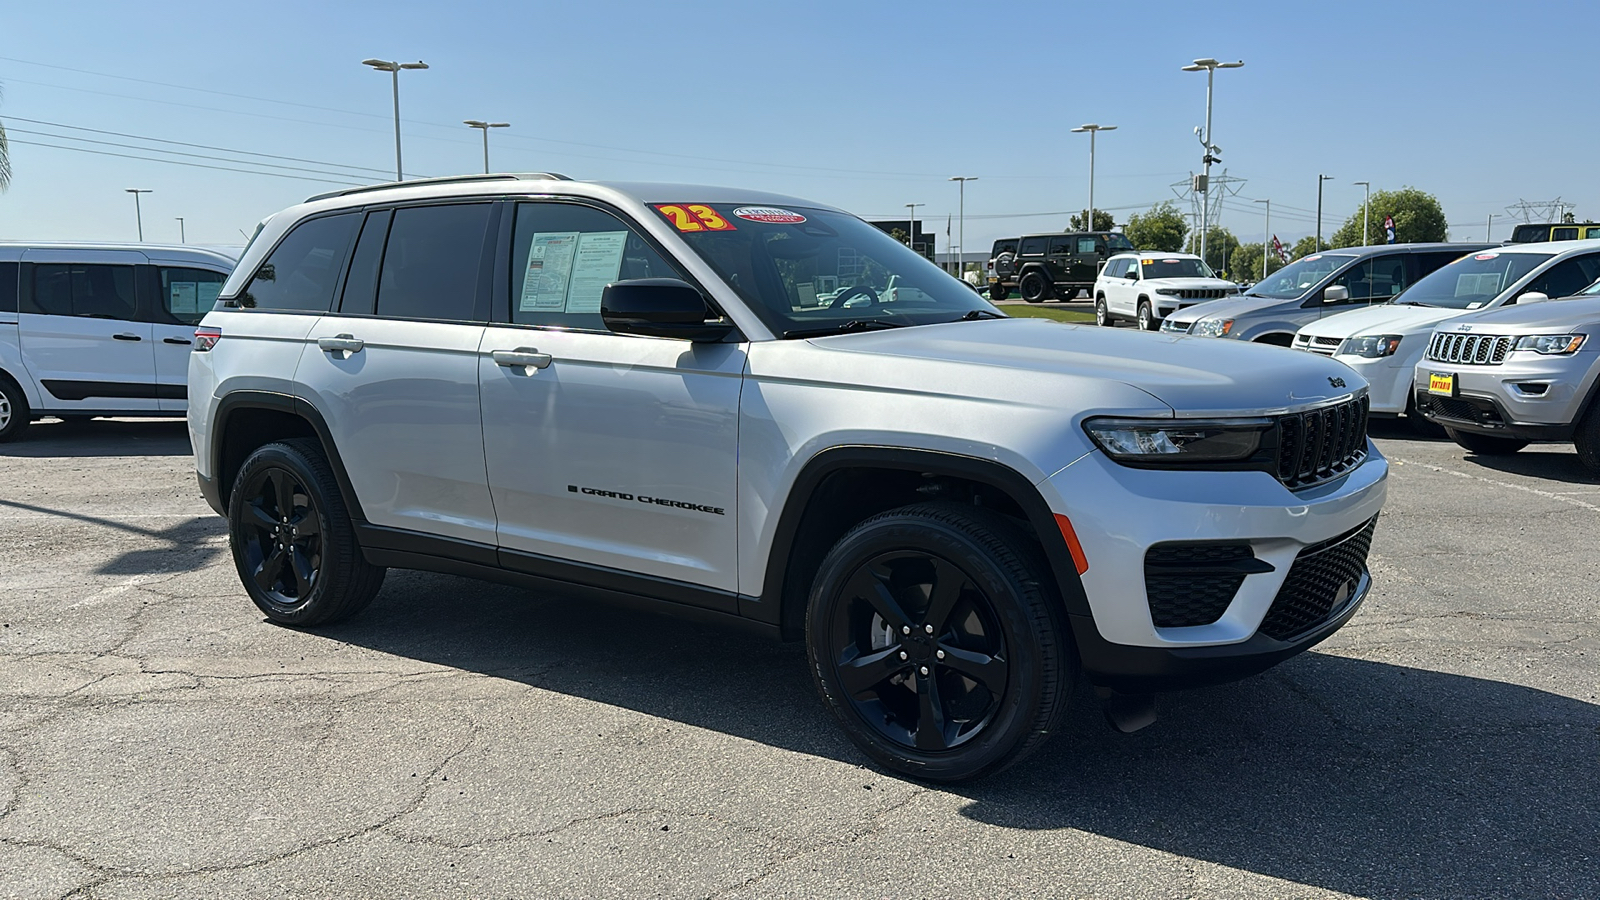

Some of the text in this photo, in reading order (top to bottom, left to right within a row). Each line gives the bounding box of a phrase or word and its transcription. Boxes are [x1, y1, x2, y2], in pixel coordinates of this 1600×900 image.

[659, 205, 728, 231] 23
[1431, 381, 1450, 390] ONTARIO
[582, 487, 725, 515] GRAND CHEROKEE
